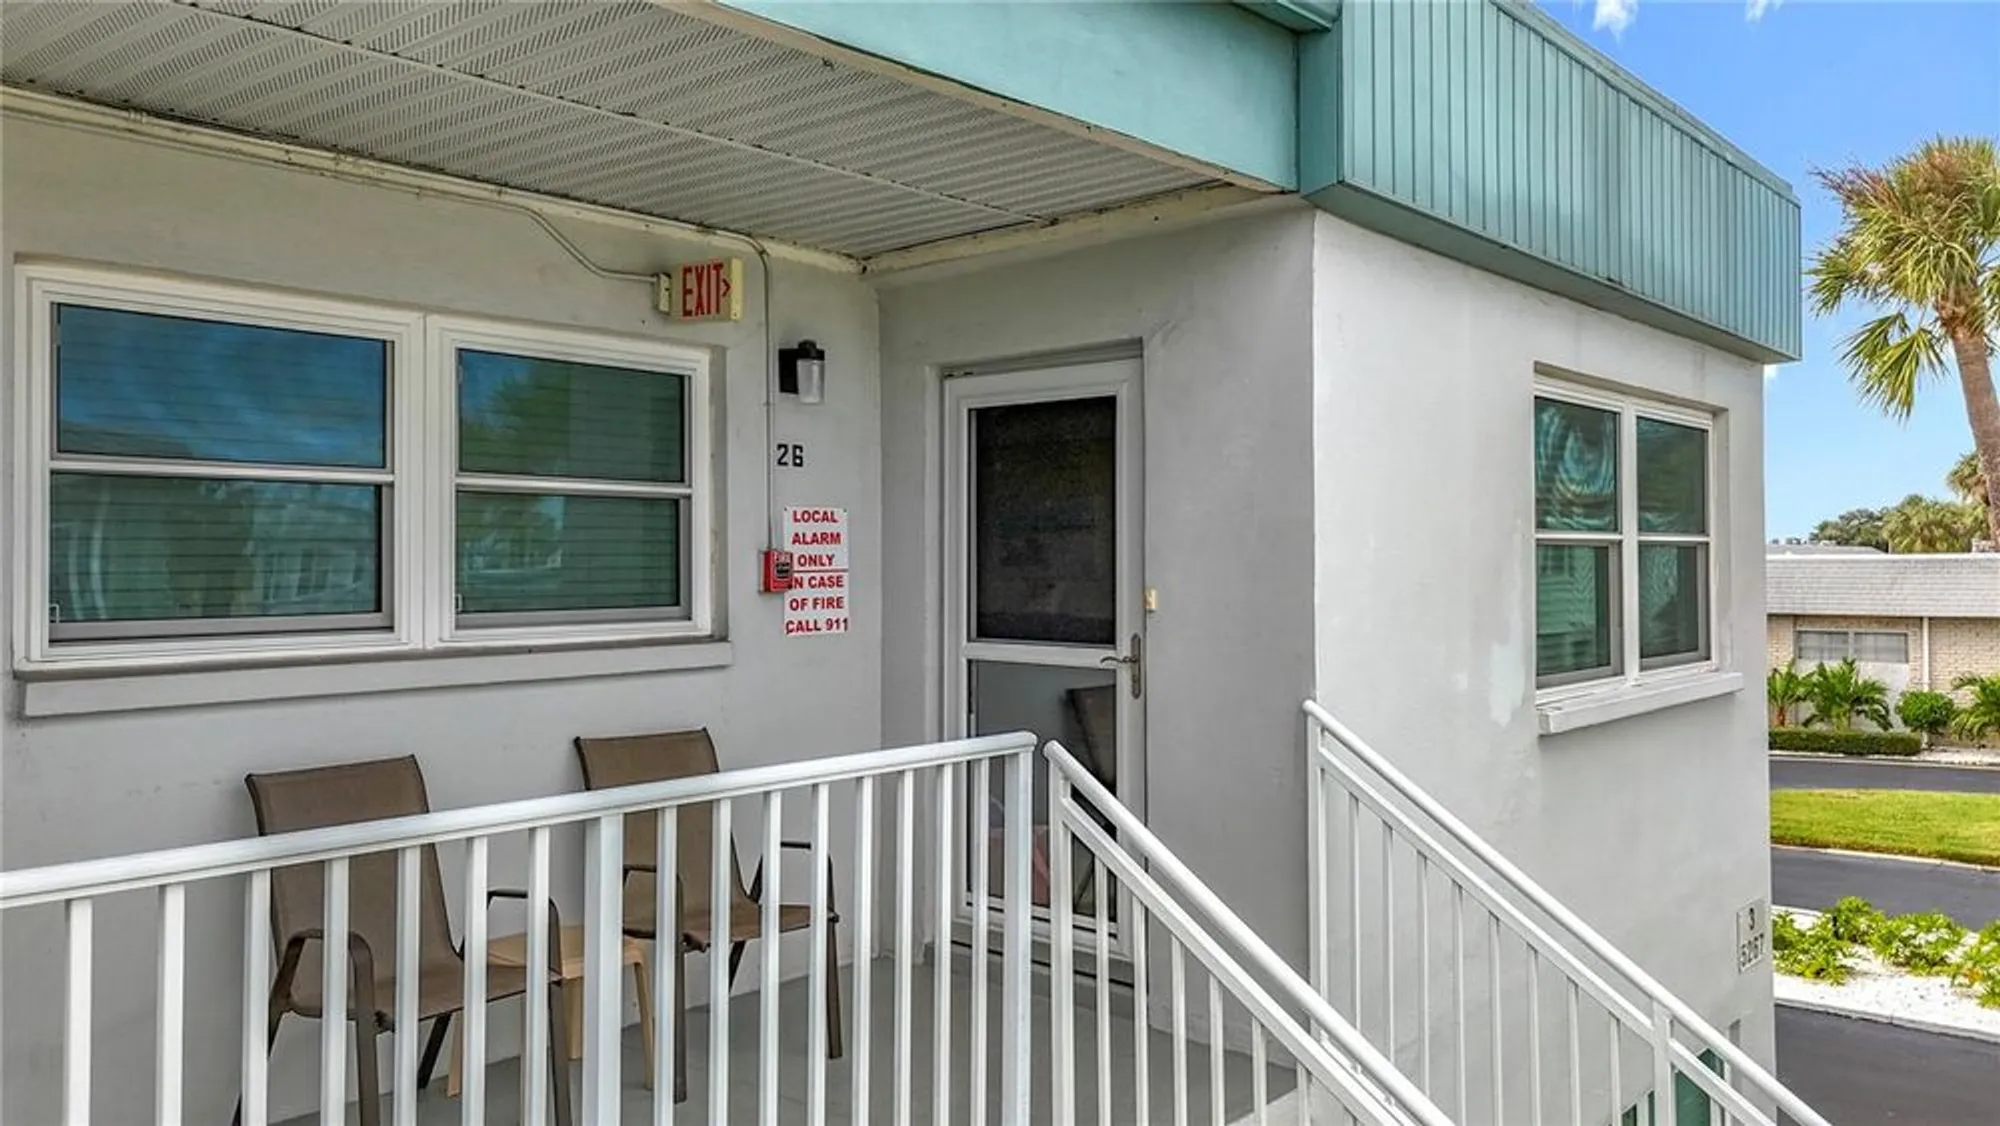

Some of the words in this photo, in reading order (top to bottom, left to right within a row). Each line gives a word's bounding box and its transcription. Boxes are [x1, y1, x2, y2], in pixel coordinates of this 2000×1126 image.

[682, 262, 724, 317] EXIT
[776, 443, 803, 468] 26
[792, 510, 838, 523] LOCAL
[791, 531, 842, 545] ALARM
[797, 554, 835, 567] ONLY
[791, 576, 803, 589] N
[807, 575, 844, 589] CASE
[789, 597, 808, 611] OF
[812, 596, 844, 610] FIRE
[785, 619, 821, 635] CALL
[825, 618, 848, 632] 911
